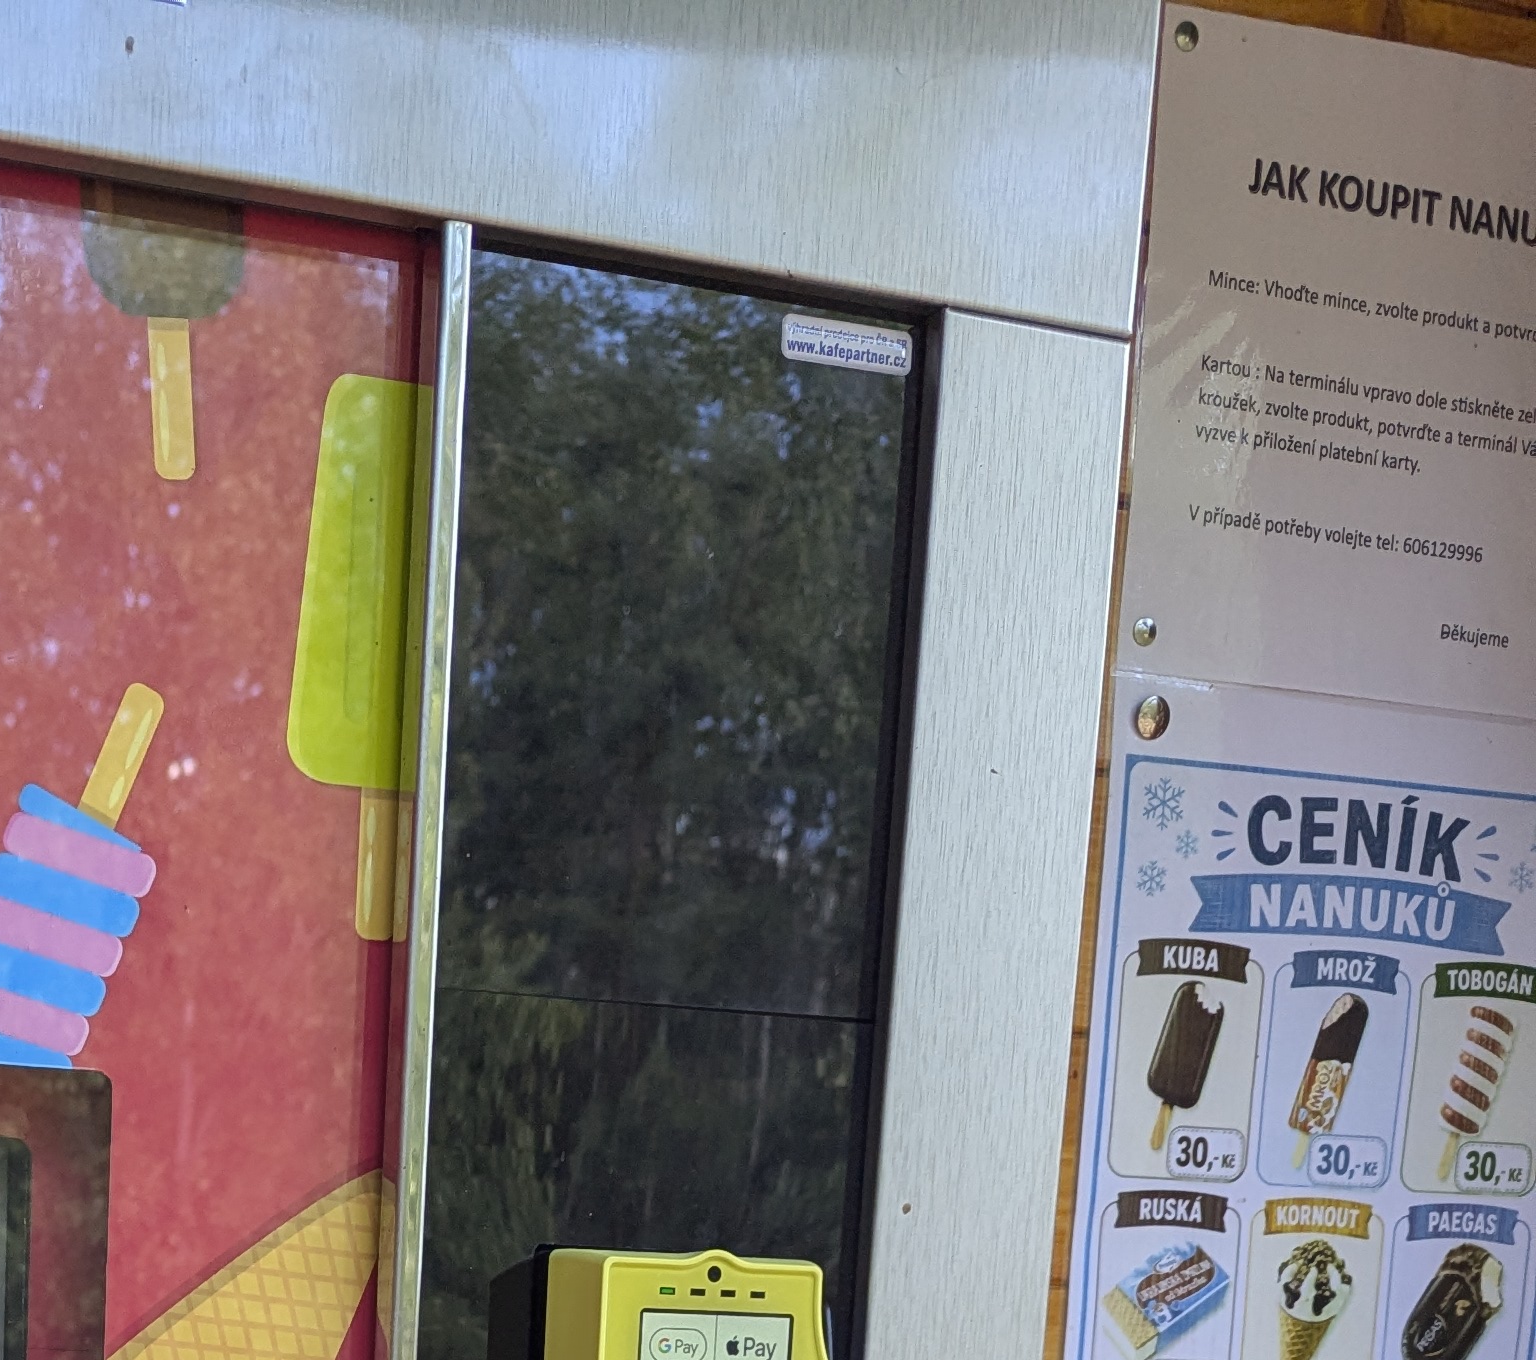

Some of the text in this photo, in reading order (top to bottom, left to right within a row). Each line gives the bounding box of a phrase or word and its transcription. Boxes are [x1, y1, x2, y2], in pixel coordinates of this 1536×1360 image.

[1248, 158, 1310, 203] JAK
[1318, 170, 1442, 227] KOUPIT
[1208, 269, 1260, 295] Mince:
[1265, 279, 1319, 305] Vhoďte
[1323, 291, 1372, 317] mince,
[1375, 301, 1419, 323] zvolte
[1422, 308, 1479, 333] produkt
[1482, 320, 1491, 334] a
[786, 339, 907, 368] www.kafepartner.cz
[1201, 354, 1252, 379] Kartou
[1265, 365, 1285, 385] Na
[1289, 369, 1360, 397] terminálu
[1363, 383, 1412, 406] vpravo
[1416, 388, 1448, 410] dole
[1451, 397, 1515, 421] stiskněte
[1198, 387, 1261, 416] kroužek,
[1265, 400, 1310, 422] zvolte
[1313, 407, 1372, 435] produkt,
[1377, 418, 1441, 444] potvrďte
[1445, 430, 1453, 445] a
[1458, 431, 1517, 454] terminál
[1195, 423, 1421, 475] vyzve k přiložení platební karty.
[1189, 504, 1484, 564] V případě potřeby volejte tel: 606129996
[1440, 623, 1510, 651] Děkujeme
[1247, 794, 1471, 882] CENÍK
[1248, 880, 1456, 941] NANUKŮ
[1162, 944, 1220, 972] KUBA
[1316, 956, 1376, 983] MROŽ
[1447, 968, 1534, 996] TOBOGÁN
[1175, 1135, 1236, 1172] 30,- Kč
[1316, 1143, 1378, 1180] 30,- Kč
[1463, 1150, 1523, 1186] 30,- Kč
[1138, 1194, 1203, 1224] RUSKÁ
[1275, 1204, 1361, 1230] KORNOUT
[1427, 1209, 1498, 1236] PAEGAS
[674, 1339, 699, 1358] Pay
